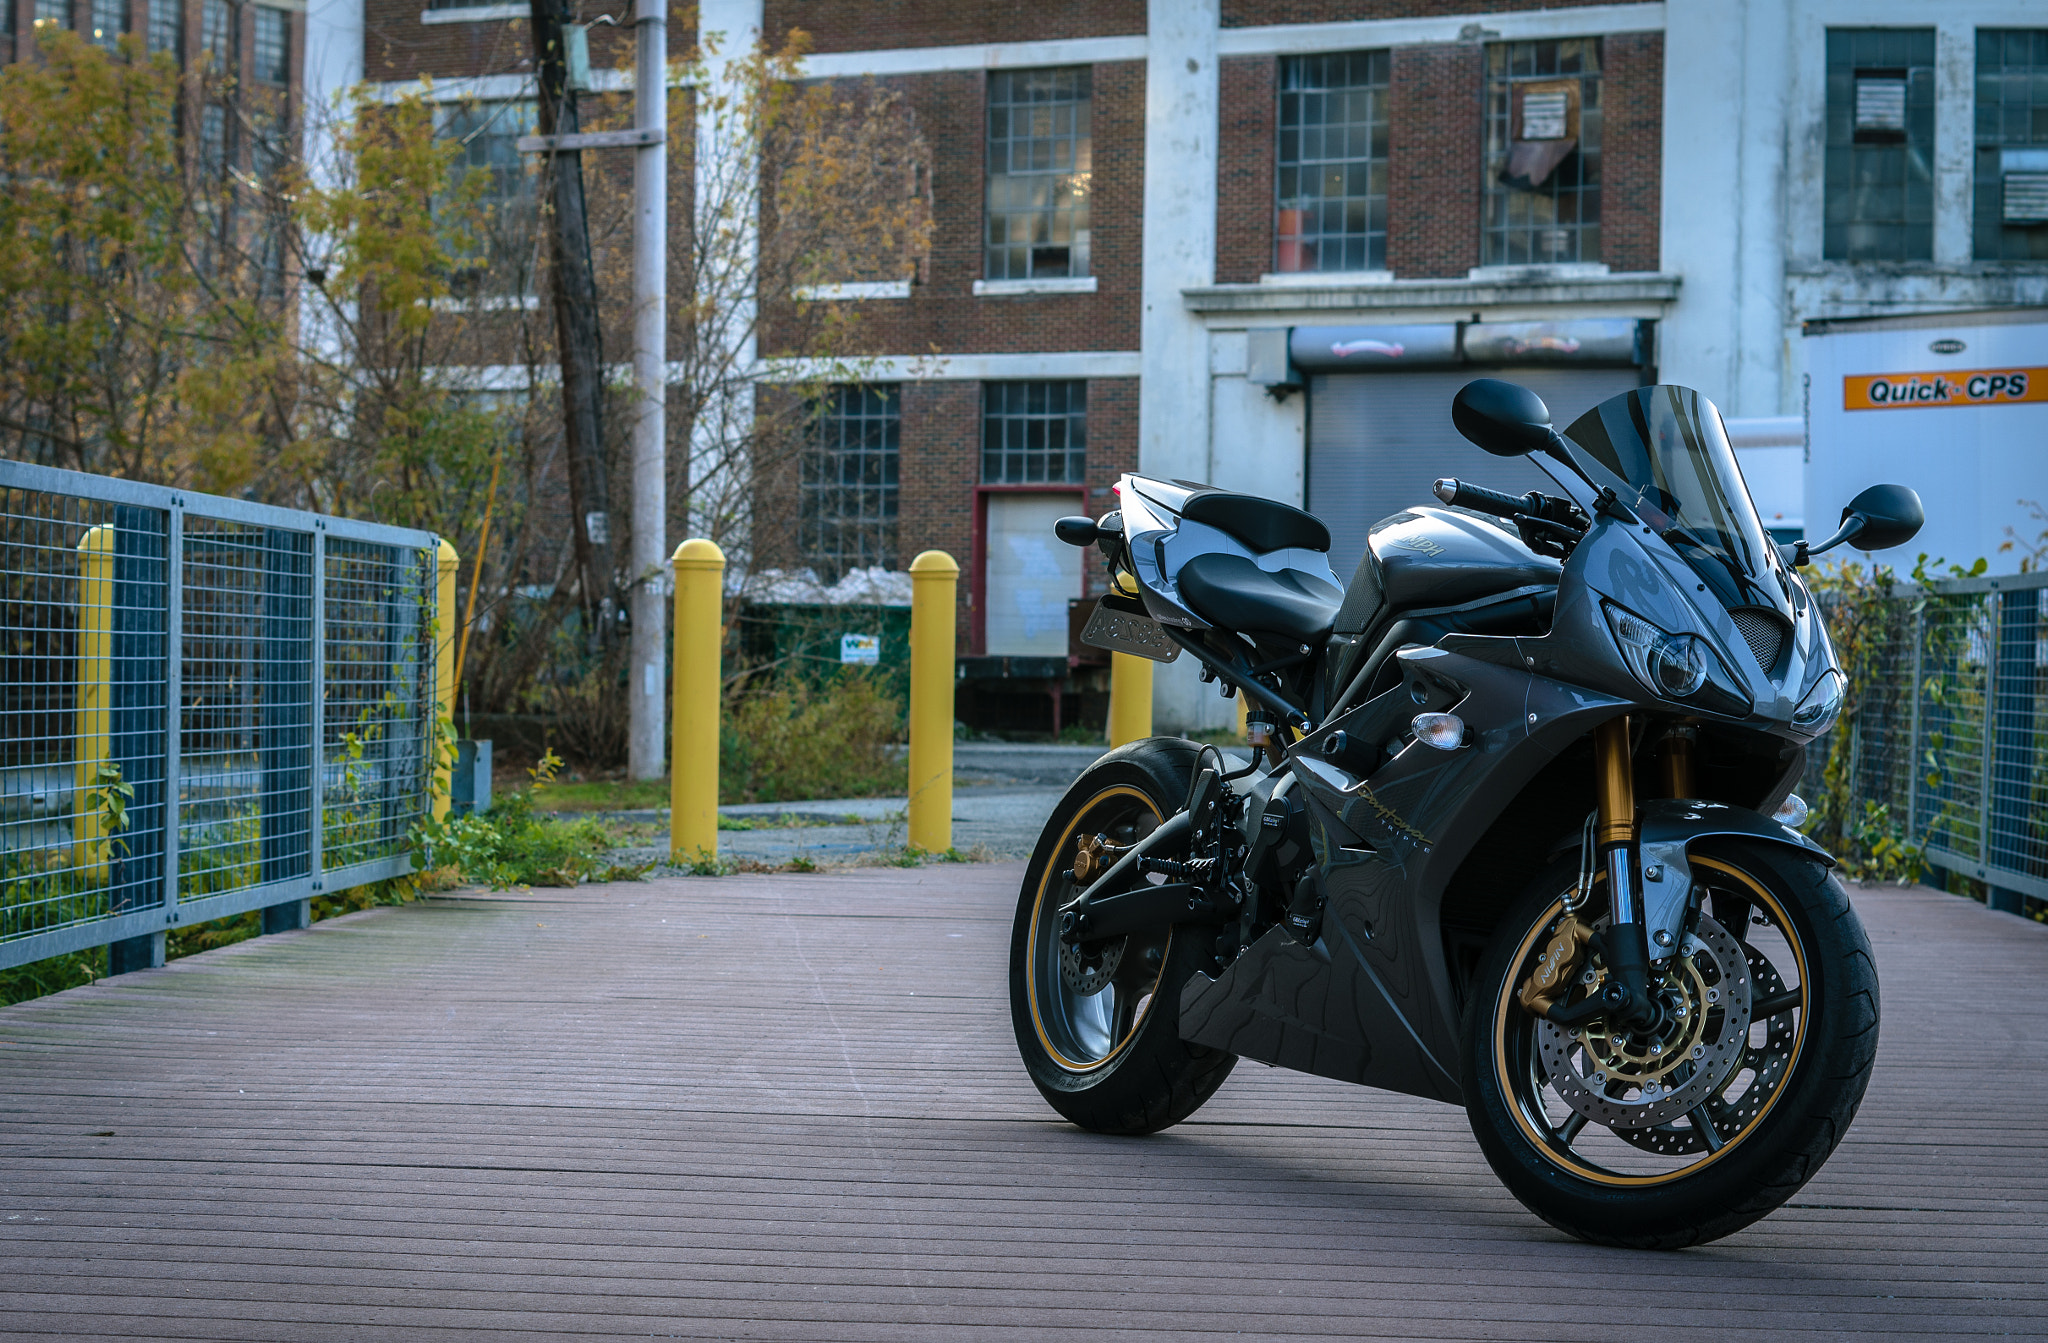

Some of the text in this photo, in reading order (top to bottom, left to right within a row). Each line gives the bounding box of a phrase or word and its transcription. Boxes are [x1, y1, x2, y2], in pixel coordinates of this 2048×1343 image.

[1869, 374, 2027, 404] Quick CPS
[1357, 784, 1434, 846] Daytona
